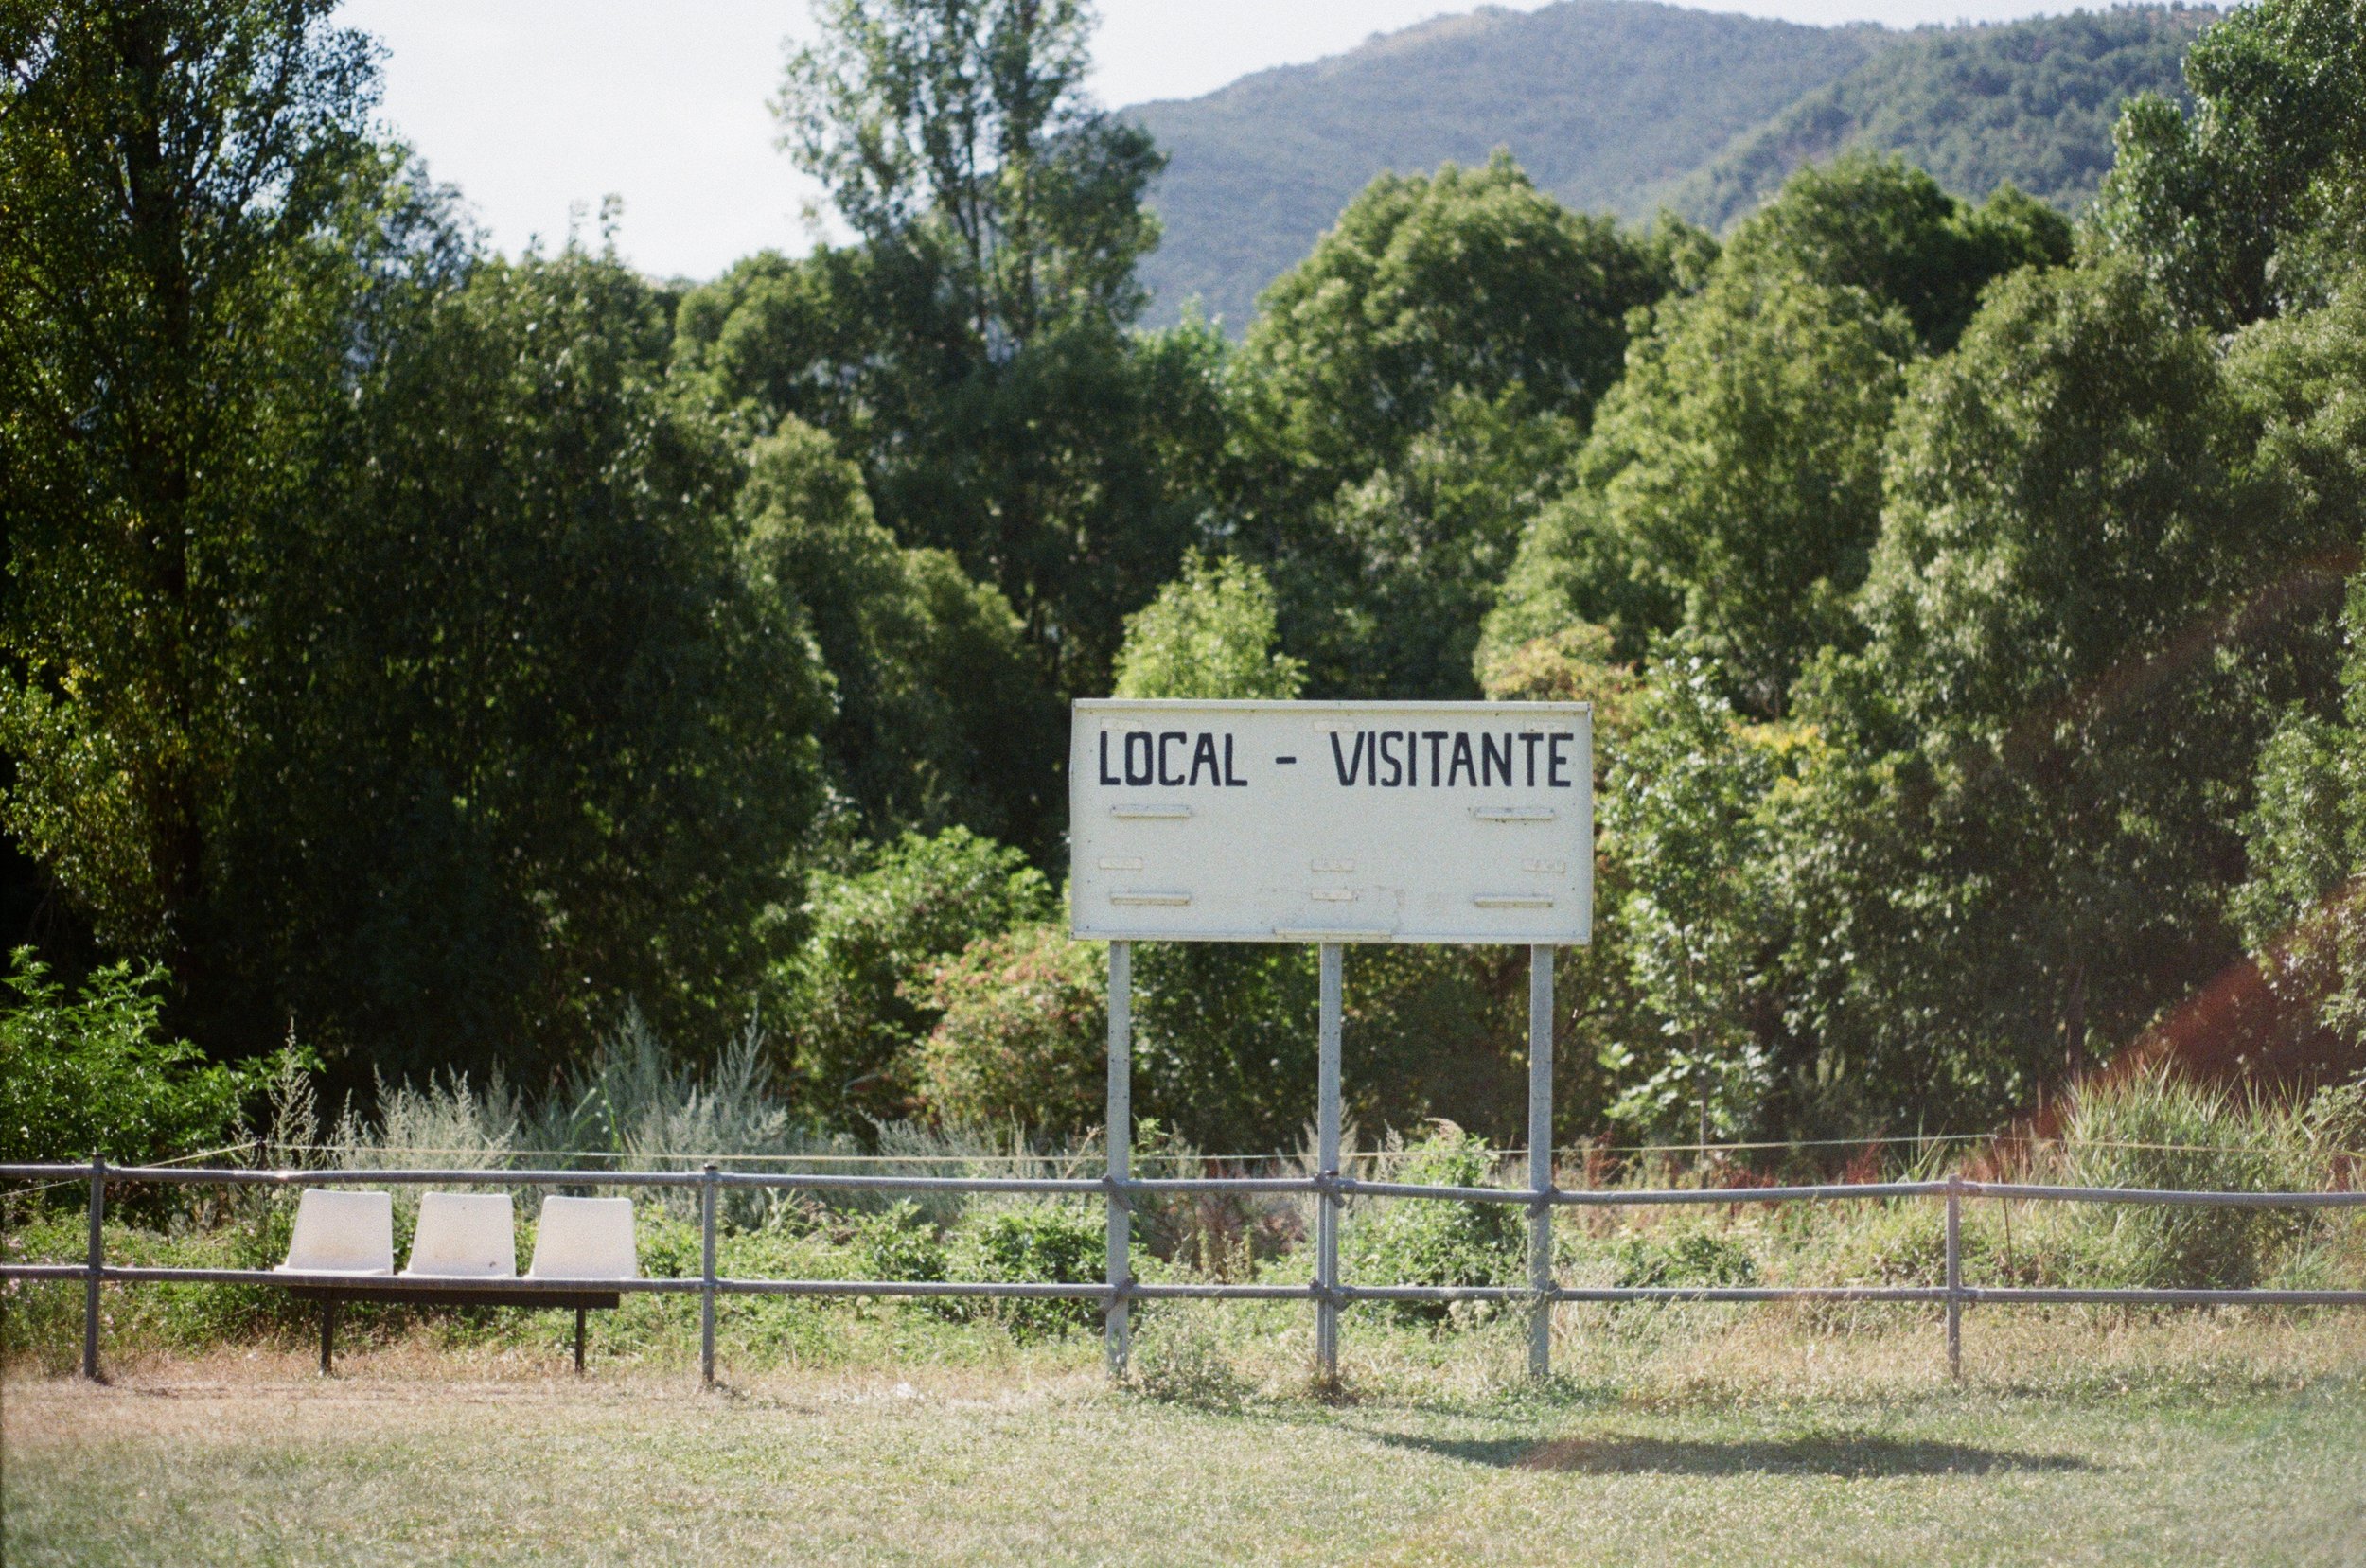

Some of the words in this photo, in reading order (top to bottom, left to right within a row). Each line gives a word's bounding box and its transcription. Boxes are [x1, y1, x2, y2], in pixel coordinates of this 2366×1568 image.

[1099, 731, 1248, 786] LOCAL
[1275, 756, 1297, 765] -
[1329, 731, 1574, 788] VISITANTE
